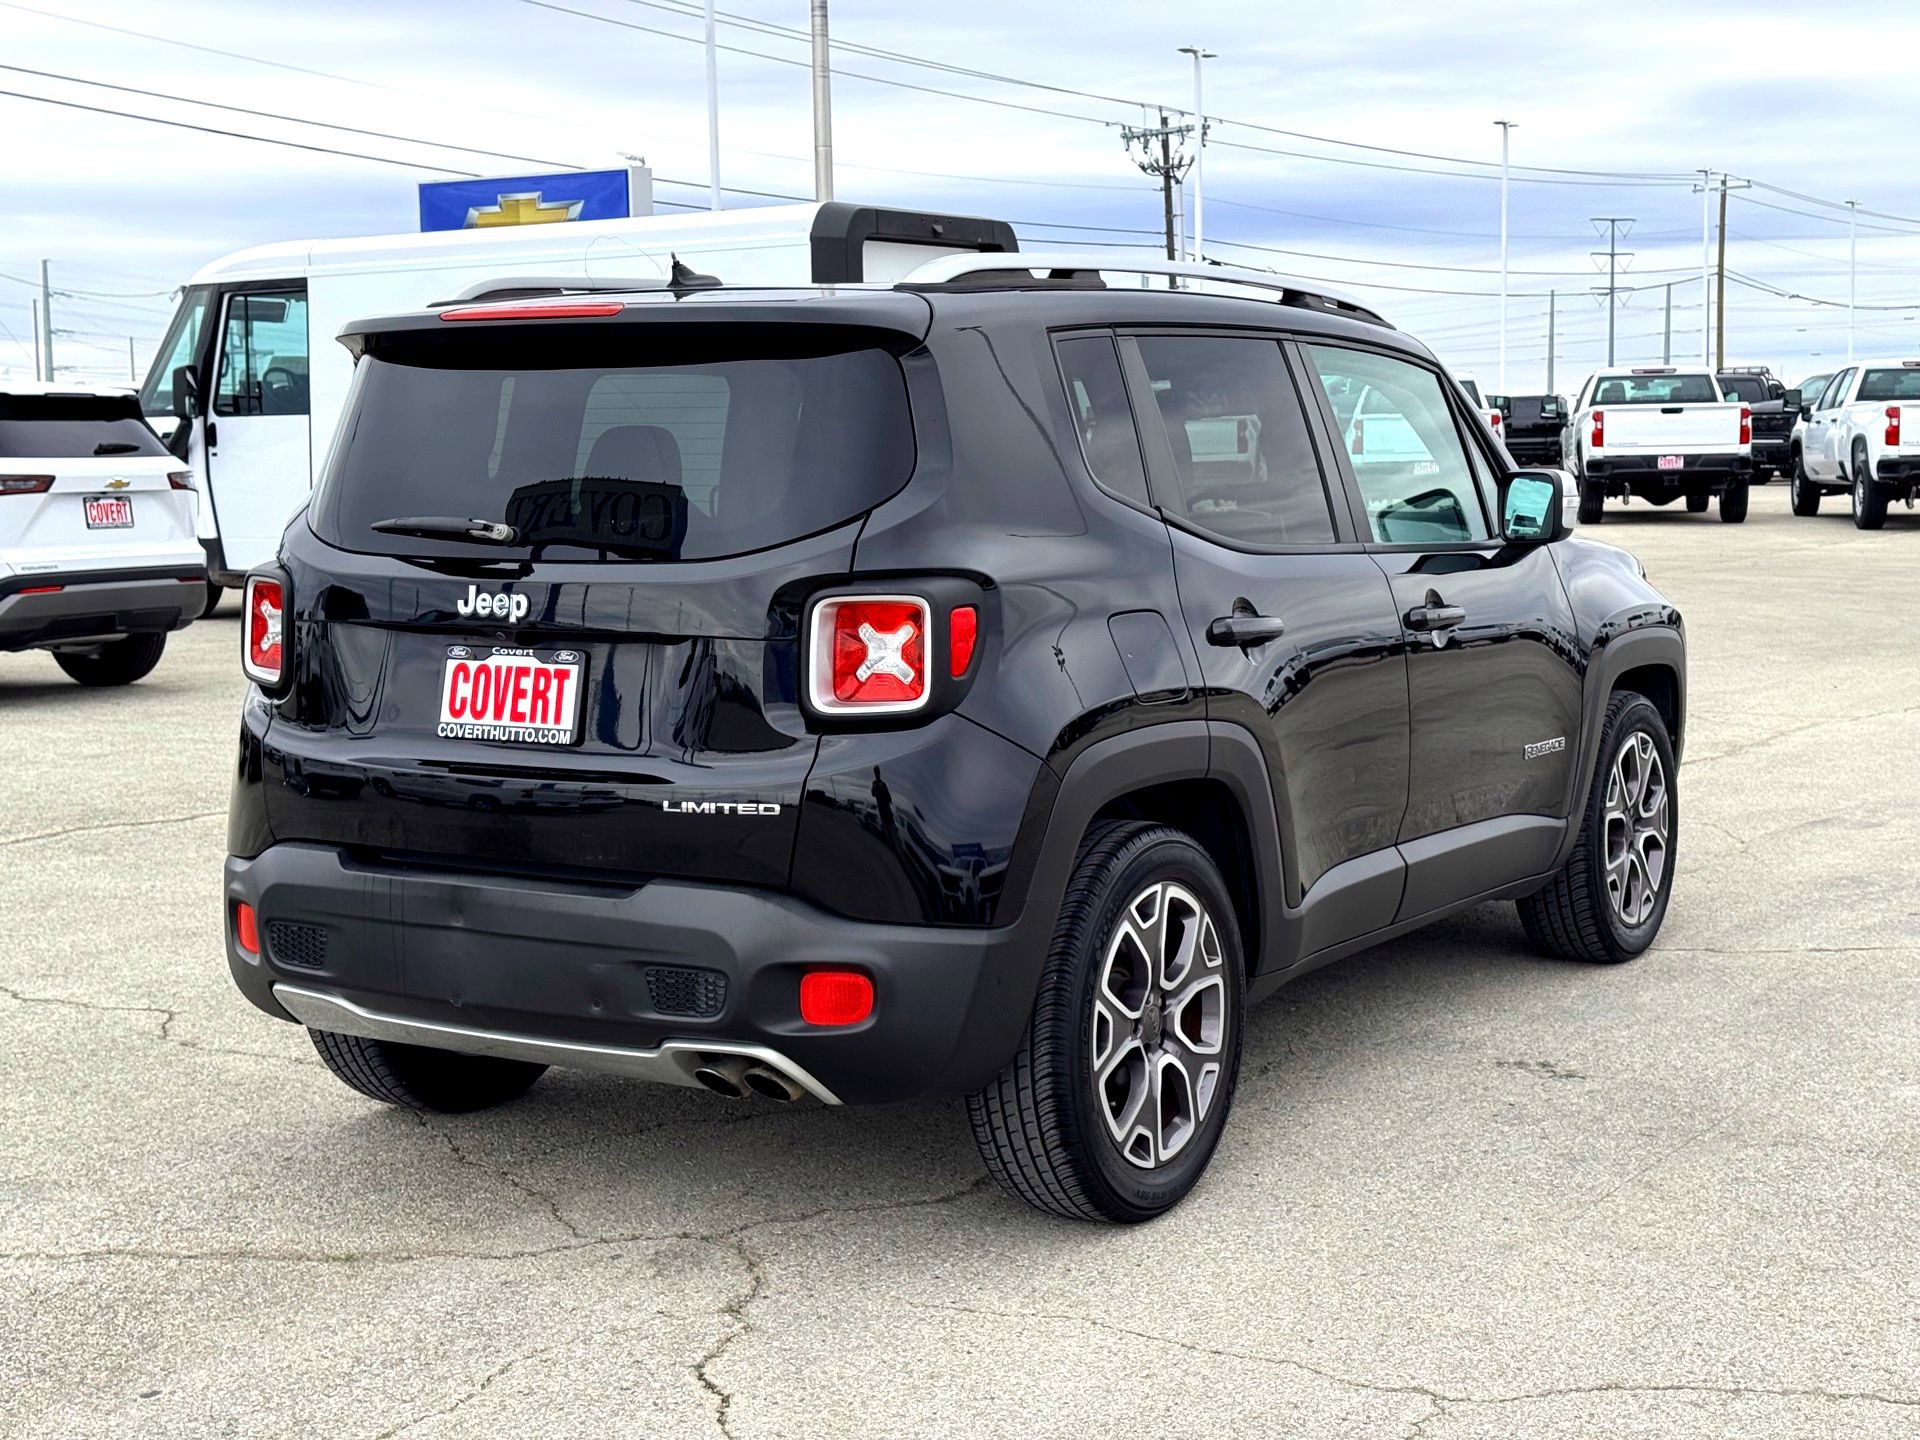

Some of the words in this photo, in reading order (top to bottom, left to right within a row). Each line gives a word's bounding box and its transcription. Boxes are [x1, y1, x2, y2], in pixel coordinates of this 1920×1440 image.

[89, 502, 128, 523] COVERT
[457, 584, 528, 624] Jeep
[491, 646, 535, 657] Covert
[448, 662, 571, 726] COVERT
[437, 722, 571, 745] COVERTHUTTO.COM
[1524, 736, 1566, 760] RENEGADE
[662, 800, 781, 816] LIMITED
